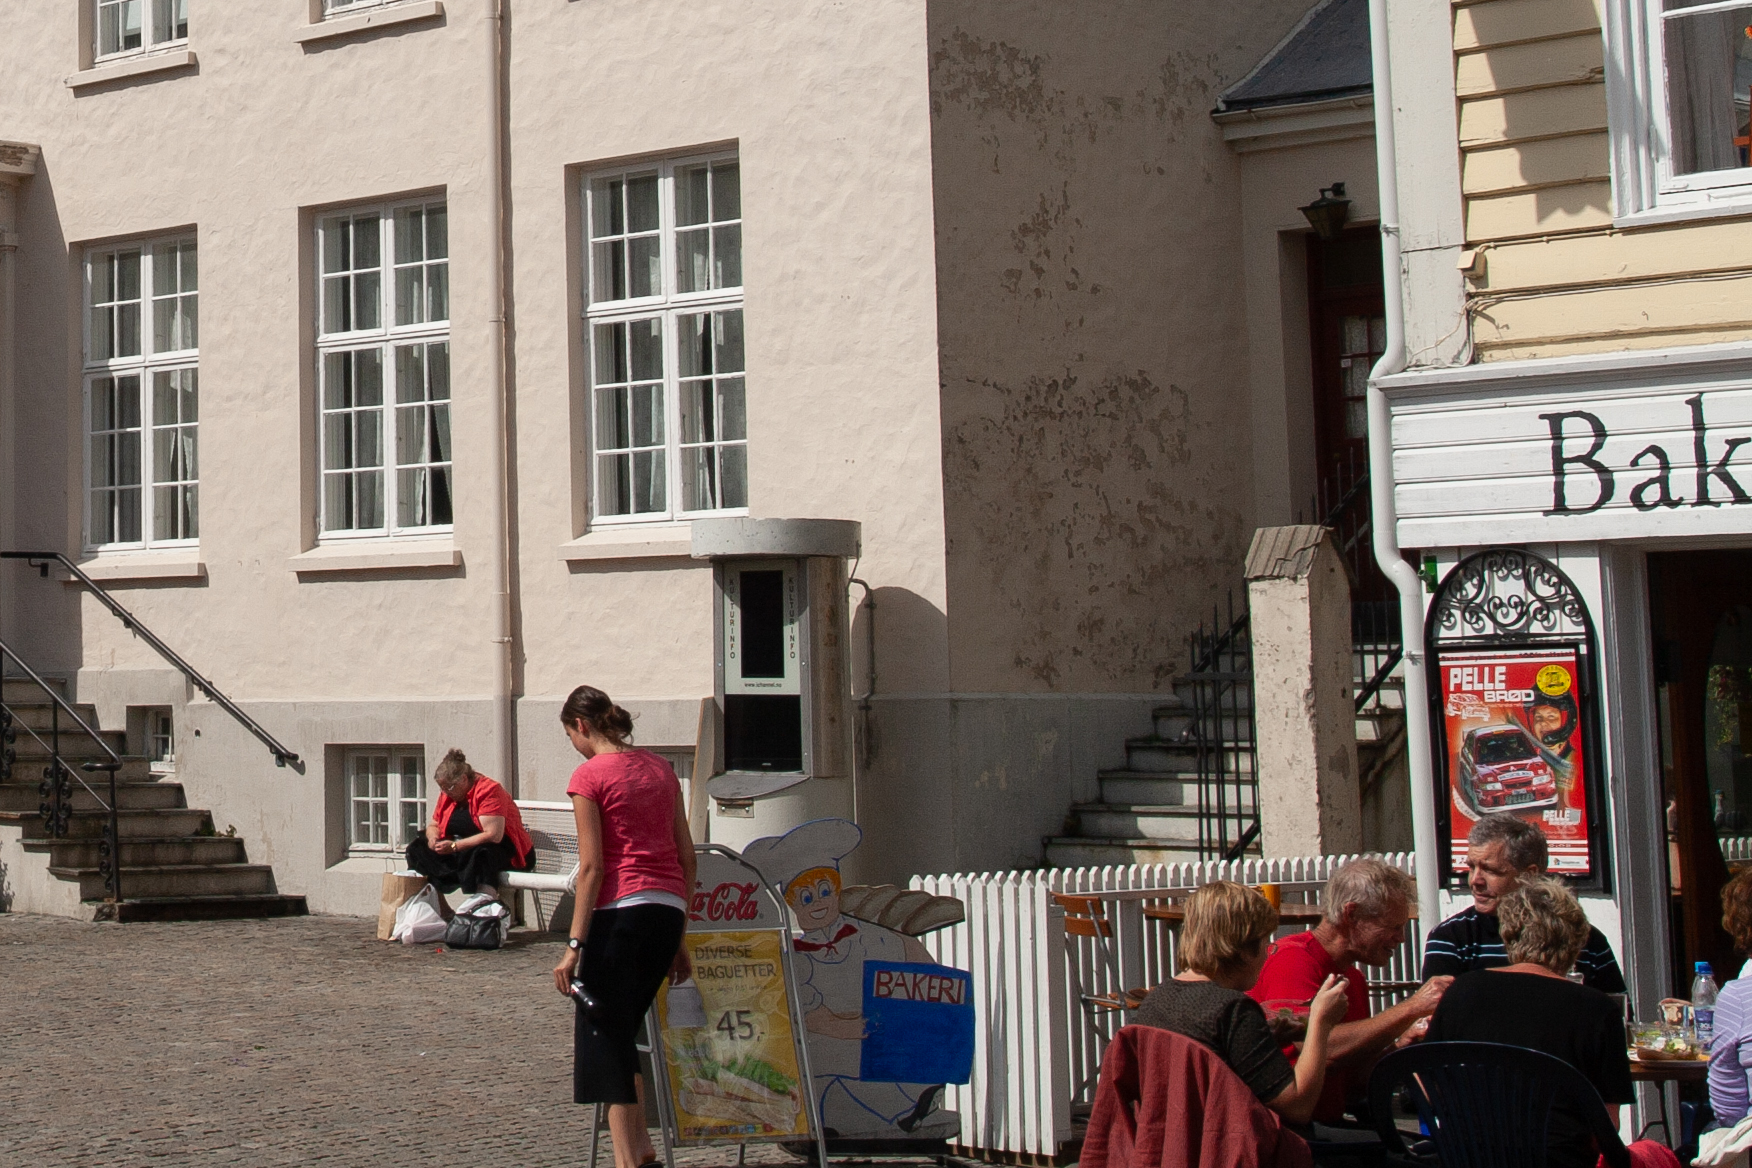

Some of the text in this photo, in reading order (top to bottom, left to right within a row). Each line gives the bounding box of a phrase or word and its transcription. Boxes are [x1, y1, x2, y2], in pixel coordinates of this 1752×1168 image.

[1538, 392, 1752, 516] Bak
[1449, 665, 1506, 691] PELLE
[1484, 689, 1534, 702] BRØD
[695, 944, 752, 959] DIVERSE
[697, 963, 776, 979] BAGUETTER
[874, 970, 963, 1004] BAKERI
